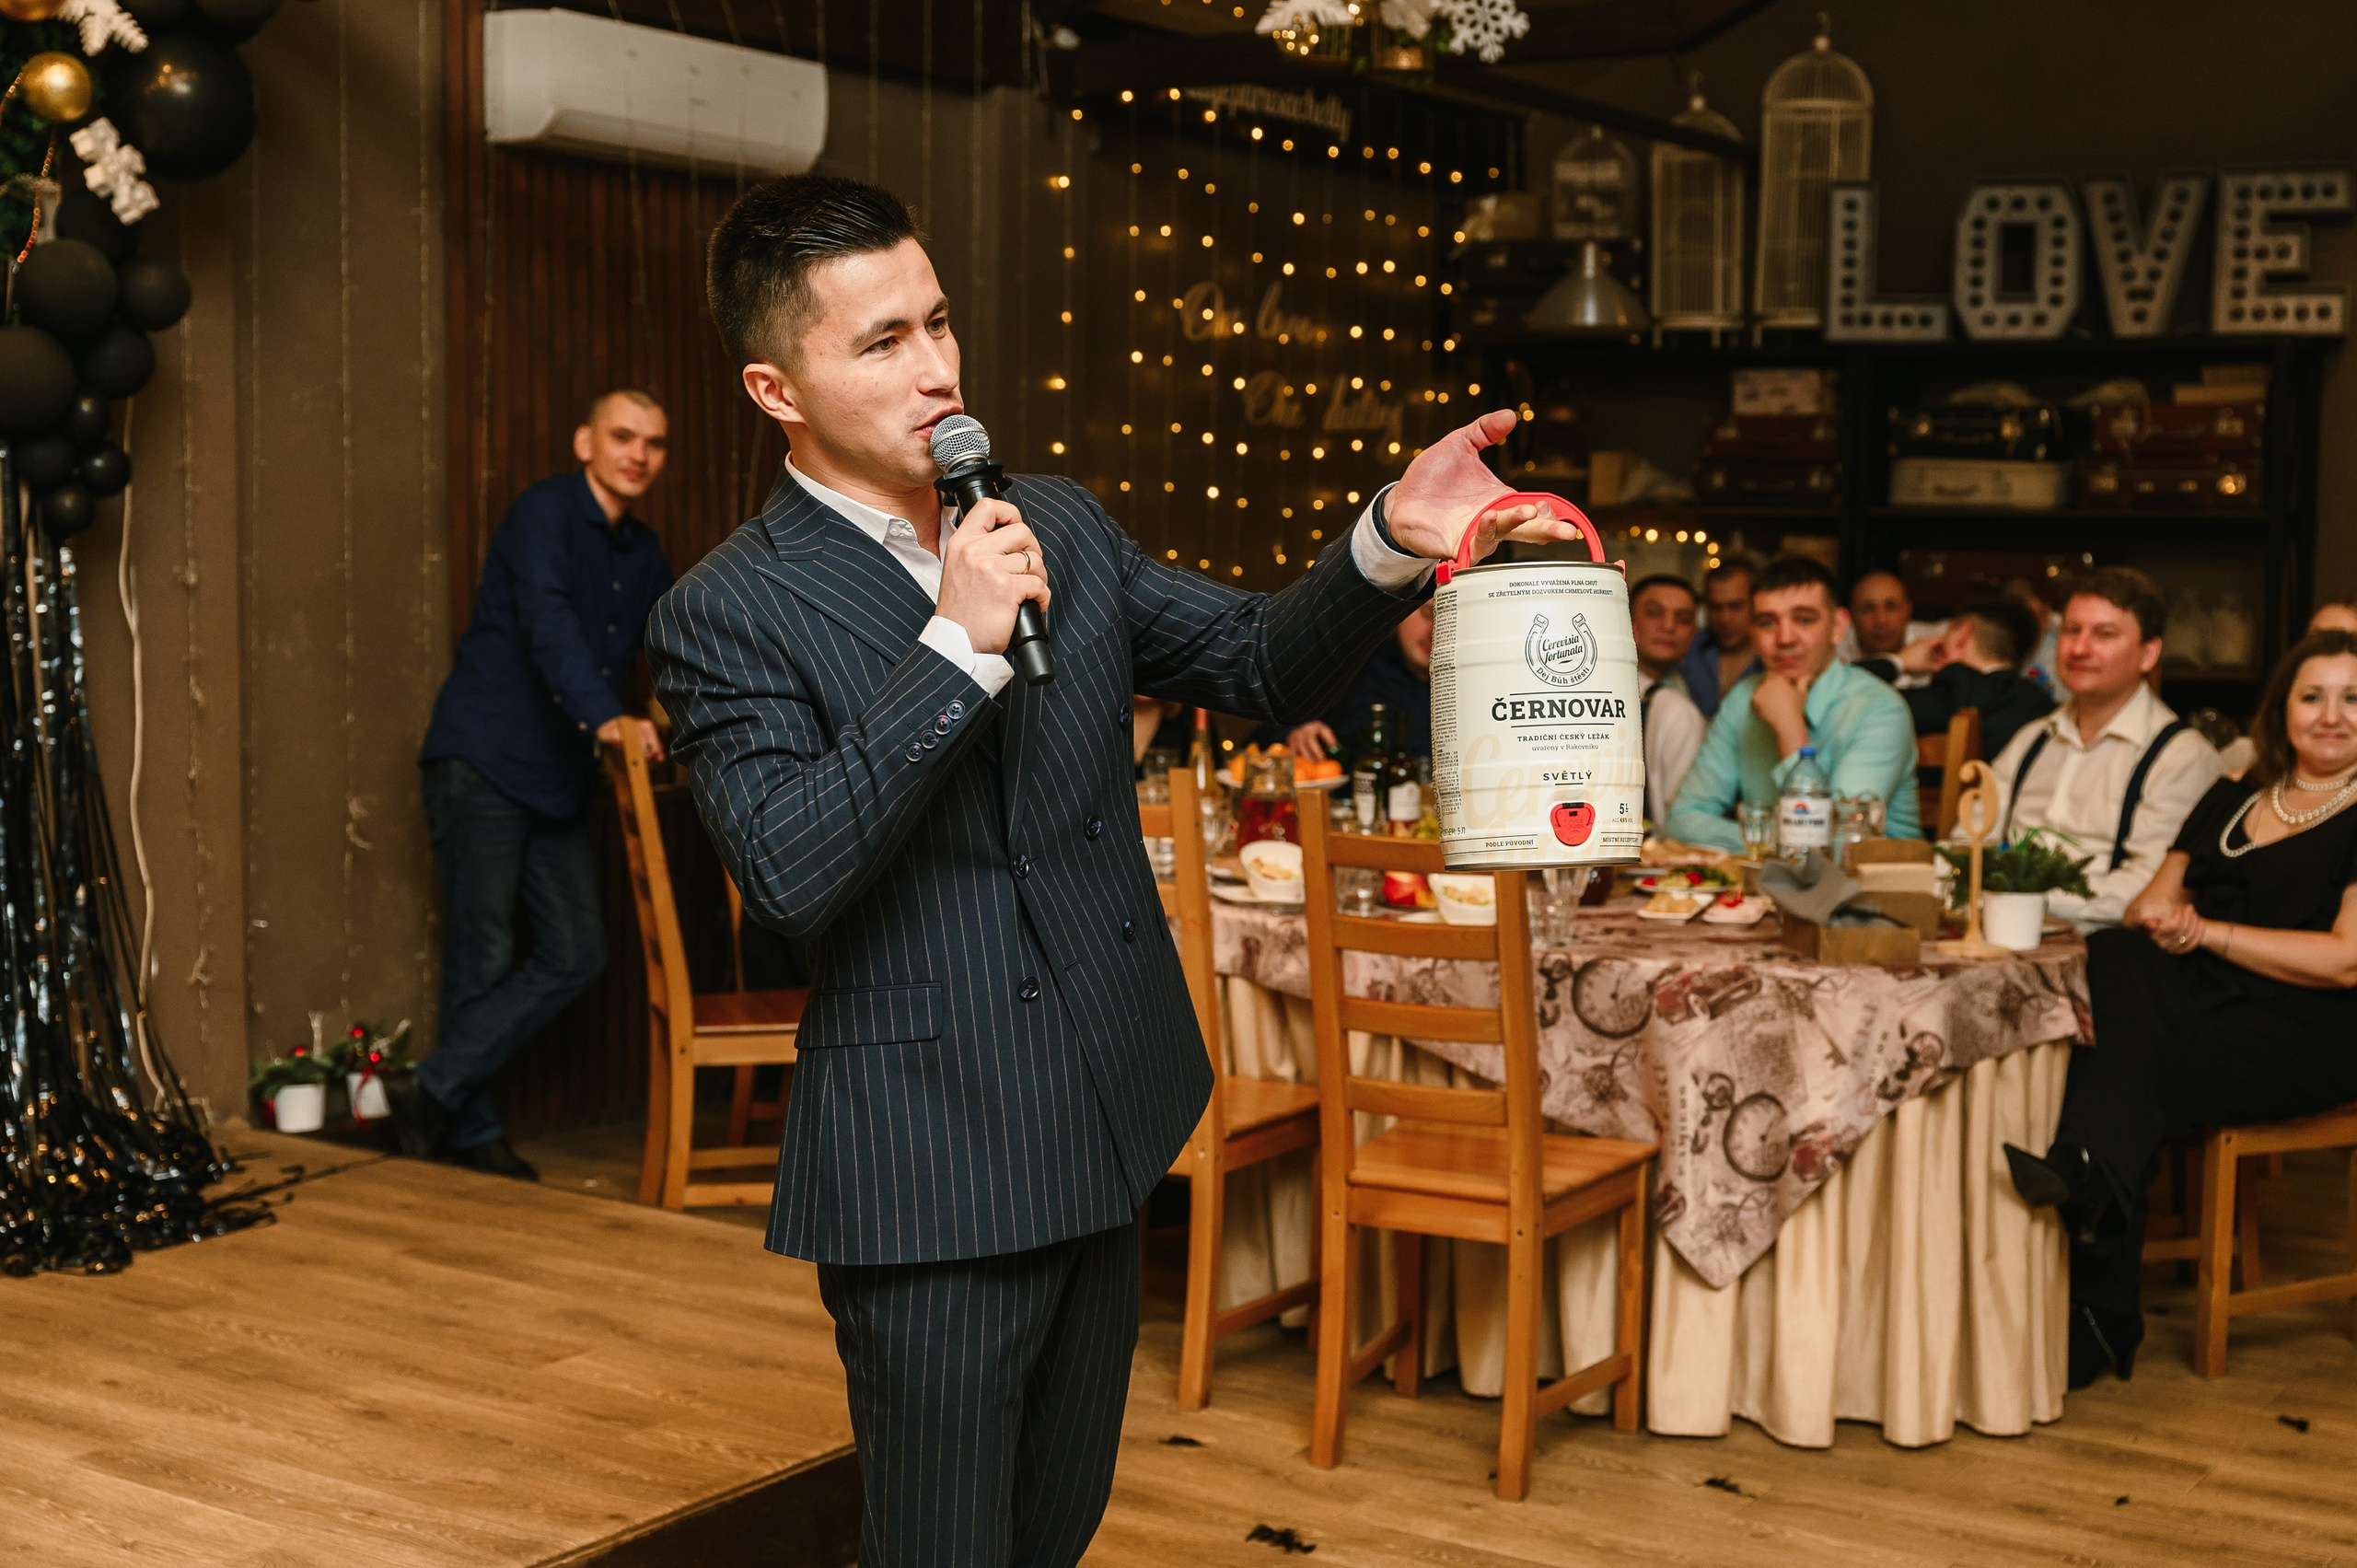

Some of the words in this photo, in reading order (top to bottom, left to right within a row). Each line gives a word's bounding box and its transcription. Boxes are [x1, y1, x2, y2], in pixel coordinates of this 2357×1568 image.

[1824, 169, 2354, 343] LOVE
[1542, 634, 1579, 651] Cerevisia
[1544, 645, 1583, 665] fortunata
[1536, 667, 1549, 680] Dej
[1551, 676, 1568, 684] Bůh
[1492, 697, 1626, 721] ČERNOVAR
[1543, 770, 1592, 781] SVĚTLÝ
